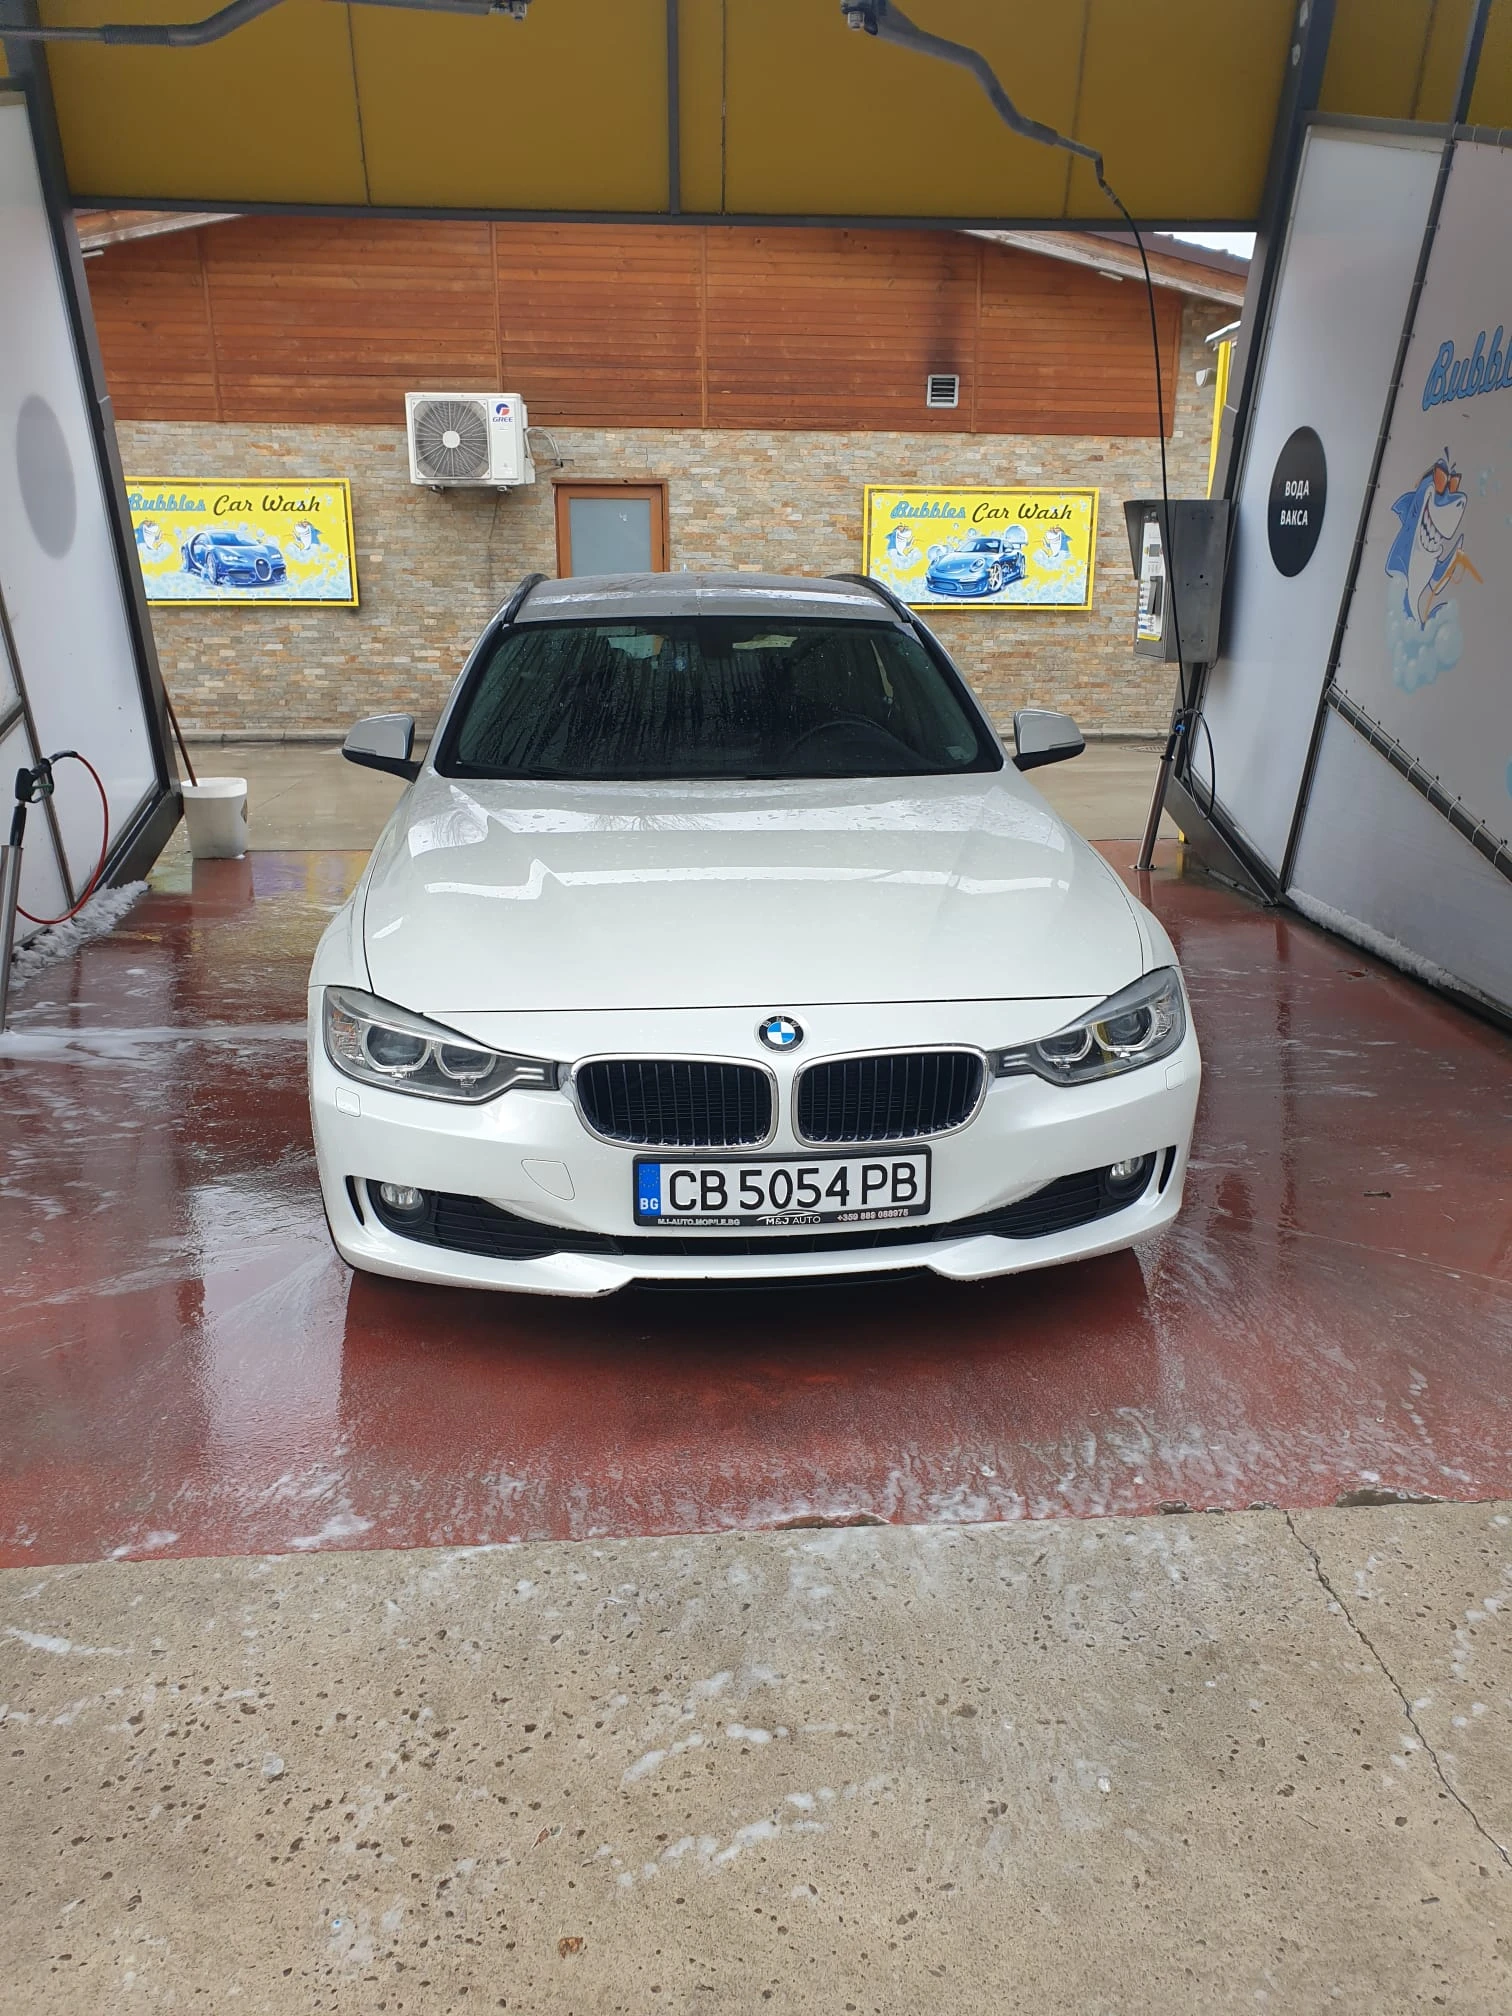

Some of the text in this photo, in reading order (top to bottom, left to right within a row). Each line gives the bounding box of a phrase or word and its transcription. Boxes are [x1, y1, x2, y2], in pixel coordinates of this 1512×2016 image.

[1284, 480, 1310, 500] ВОДА
[128, 493, 320, 516] Bubbles Car Wash
[890, 500, 1072, 523] Bubbles Car Wash
[1280, 509, 1309, 526] ВАКСА
[669, 1162, 918, 1211] CB 5054 PB
[639, 1197, 659, 1211] BG
[766, 1215, 821, 1225] M&J AUTO
[837, 1213, 858, 1222] +359
